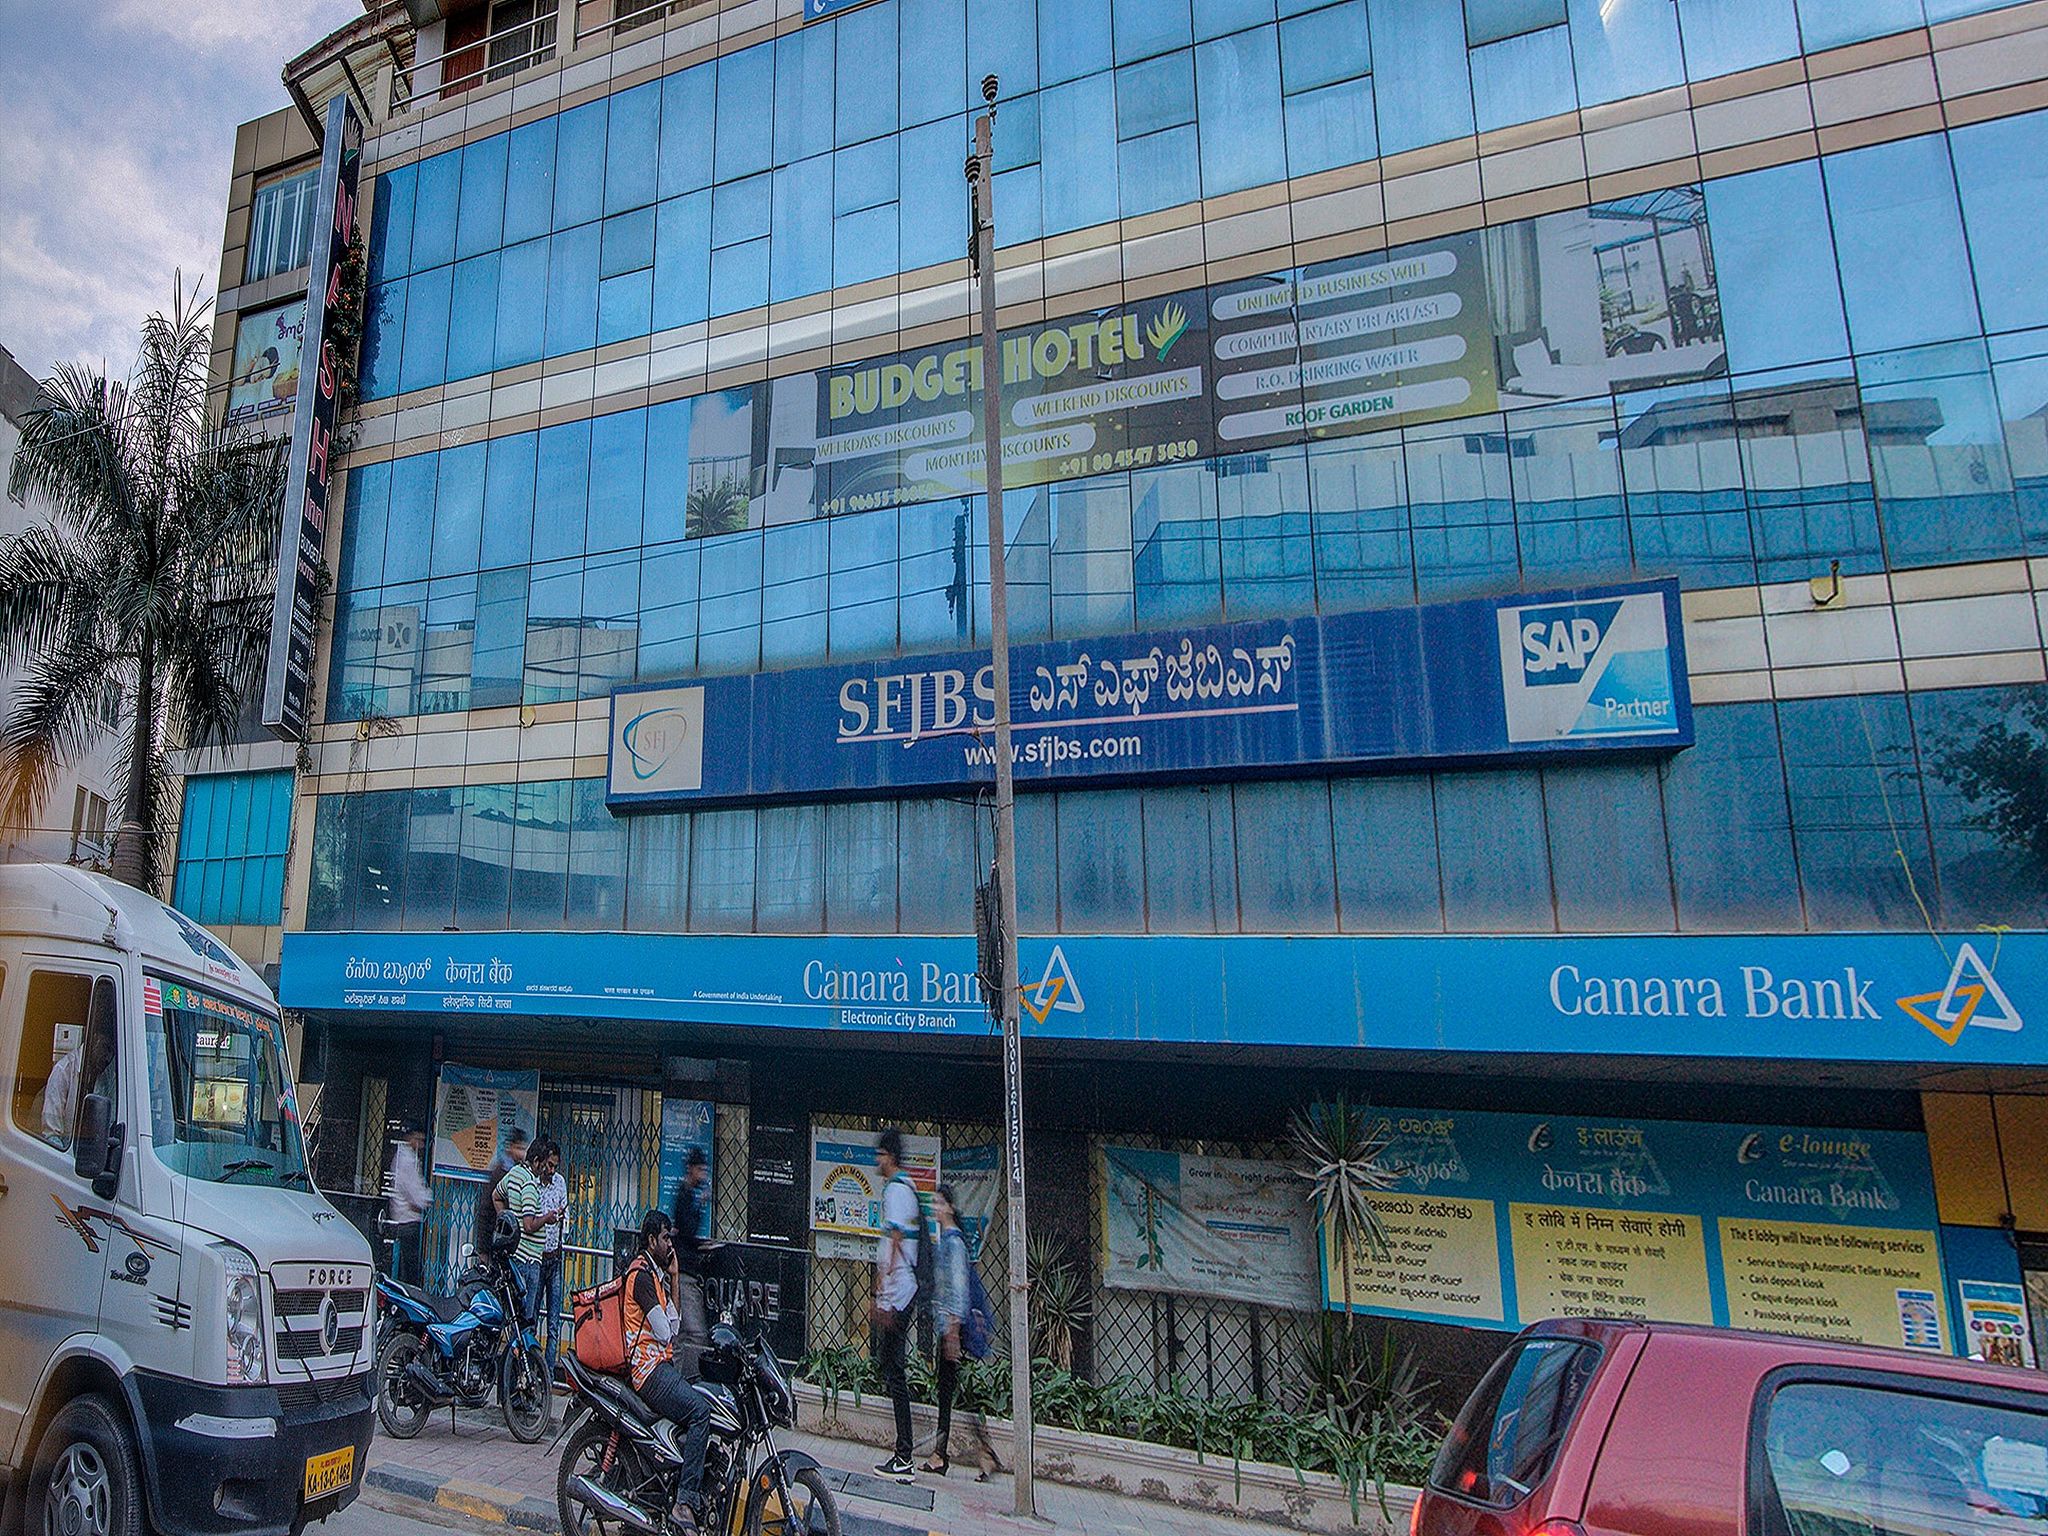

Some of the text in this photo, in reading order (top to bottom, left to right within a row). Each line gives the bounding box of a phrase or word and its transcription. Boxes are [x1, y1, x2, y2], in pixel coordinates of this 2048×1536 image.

[1317, 272, 1388, 297] BUSINESS
[1391, 261, 1428, 281] WIFI
[1229, 302, 1439, 353] COMPLIMNTARY BREAKFAST
[830, 314, 1145, 419] BUDGET HOTEL
[1255, 349, 1419, 391] R.O. DRINKING WATER
[1032, 377, 1188, 418] WEEKEND DISCOUNTS
[1285, 396, 1394, 427] ROOF GARDEN
[817, 418, 956, 457] WEEKDAYS DISCOUNTS
[1003, 432, 1071, 459] ISCOUNTS
[304, 488, 323, 532] Inn
[1522, 618, 1600, 673] SAP
[838, 667, 994, 748] SFJBS
[1605, 697, 1669, 719] Partner
[643, 730, 667, 752] SFJ
[345, 956, 432, 986] ಕೆನರಾ ಬ್ಯಾಂಕ್
[445, 956, 513, 984] केनरा बैंक
[803, 959, 984, 1003] Canara Ban
[693, 990, 698, 998] A
[697, 990, 729, 999] Government
[730, 991, 735, 999] of
[749, 993, 782, 1003] Undertaking
[1549, 964, 1882, 1020] Canara Bank
[841, 1010, 956, 1029] Electronic City Branch
[1779, 1133, 1871, 1161] e-lounge
[824, 1166, 848, 1190] DIGITAL
[1189, 1168, 1211, 1177] Grow
[1241, 1172, 1262, 1183] right
[1542, 1163, 1648, 1196] केनरा बैंक
[1745, 1179, 1888, 1210] Canara Bank
[1524, 1212, 1533, 1228] इ
[1571, 1211, 1580, 1228] में
[1586, 1212, 1614, 1231] निम्न
[1659, 1218, 1686, 1237] होगी
[1730, 1228, 1925, 1254] The E lobby will have the following services
[308, 1268, 352, 1286] FORCE
[1746, 1257, 1921, 1279] Service through Automatic Teller Machine
[1749, 1274, 1824, 1289] Cash deposit kiosk
[1751, 1291, 1839, 1308] Cheque deposit kiosk
[1753, 1309, 1851, 1327] Passbook printing kiosk
